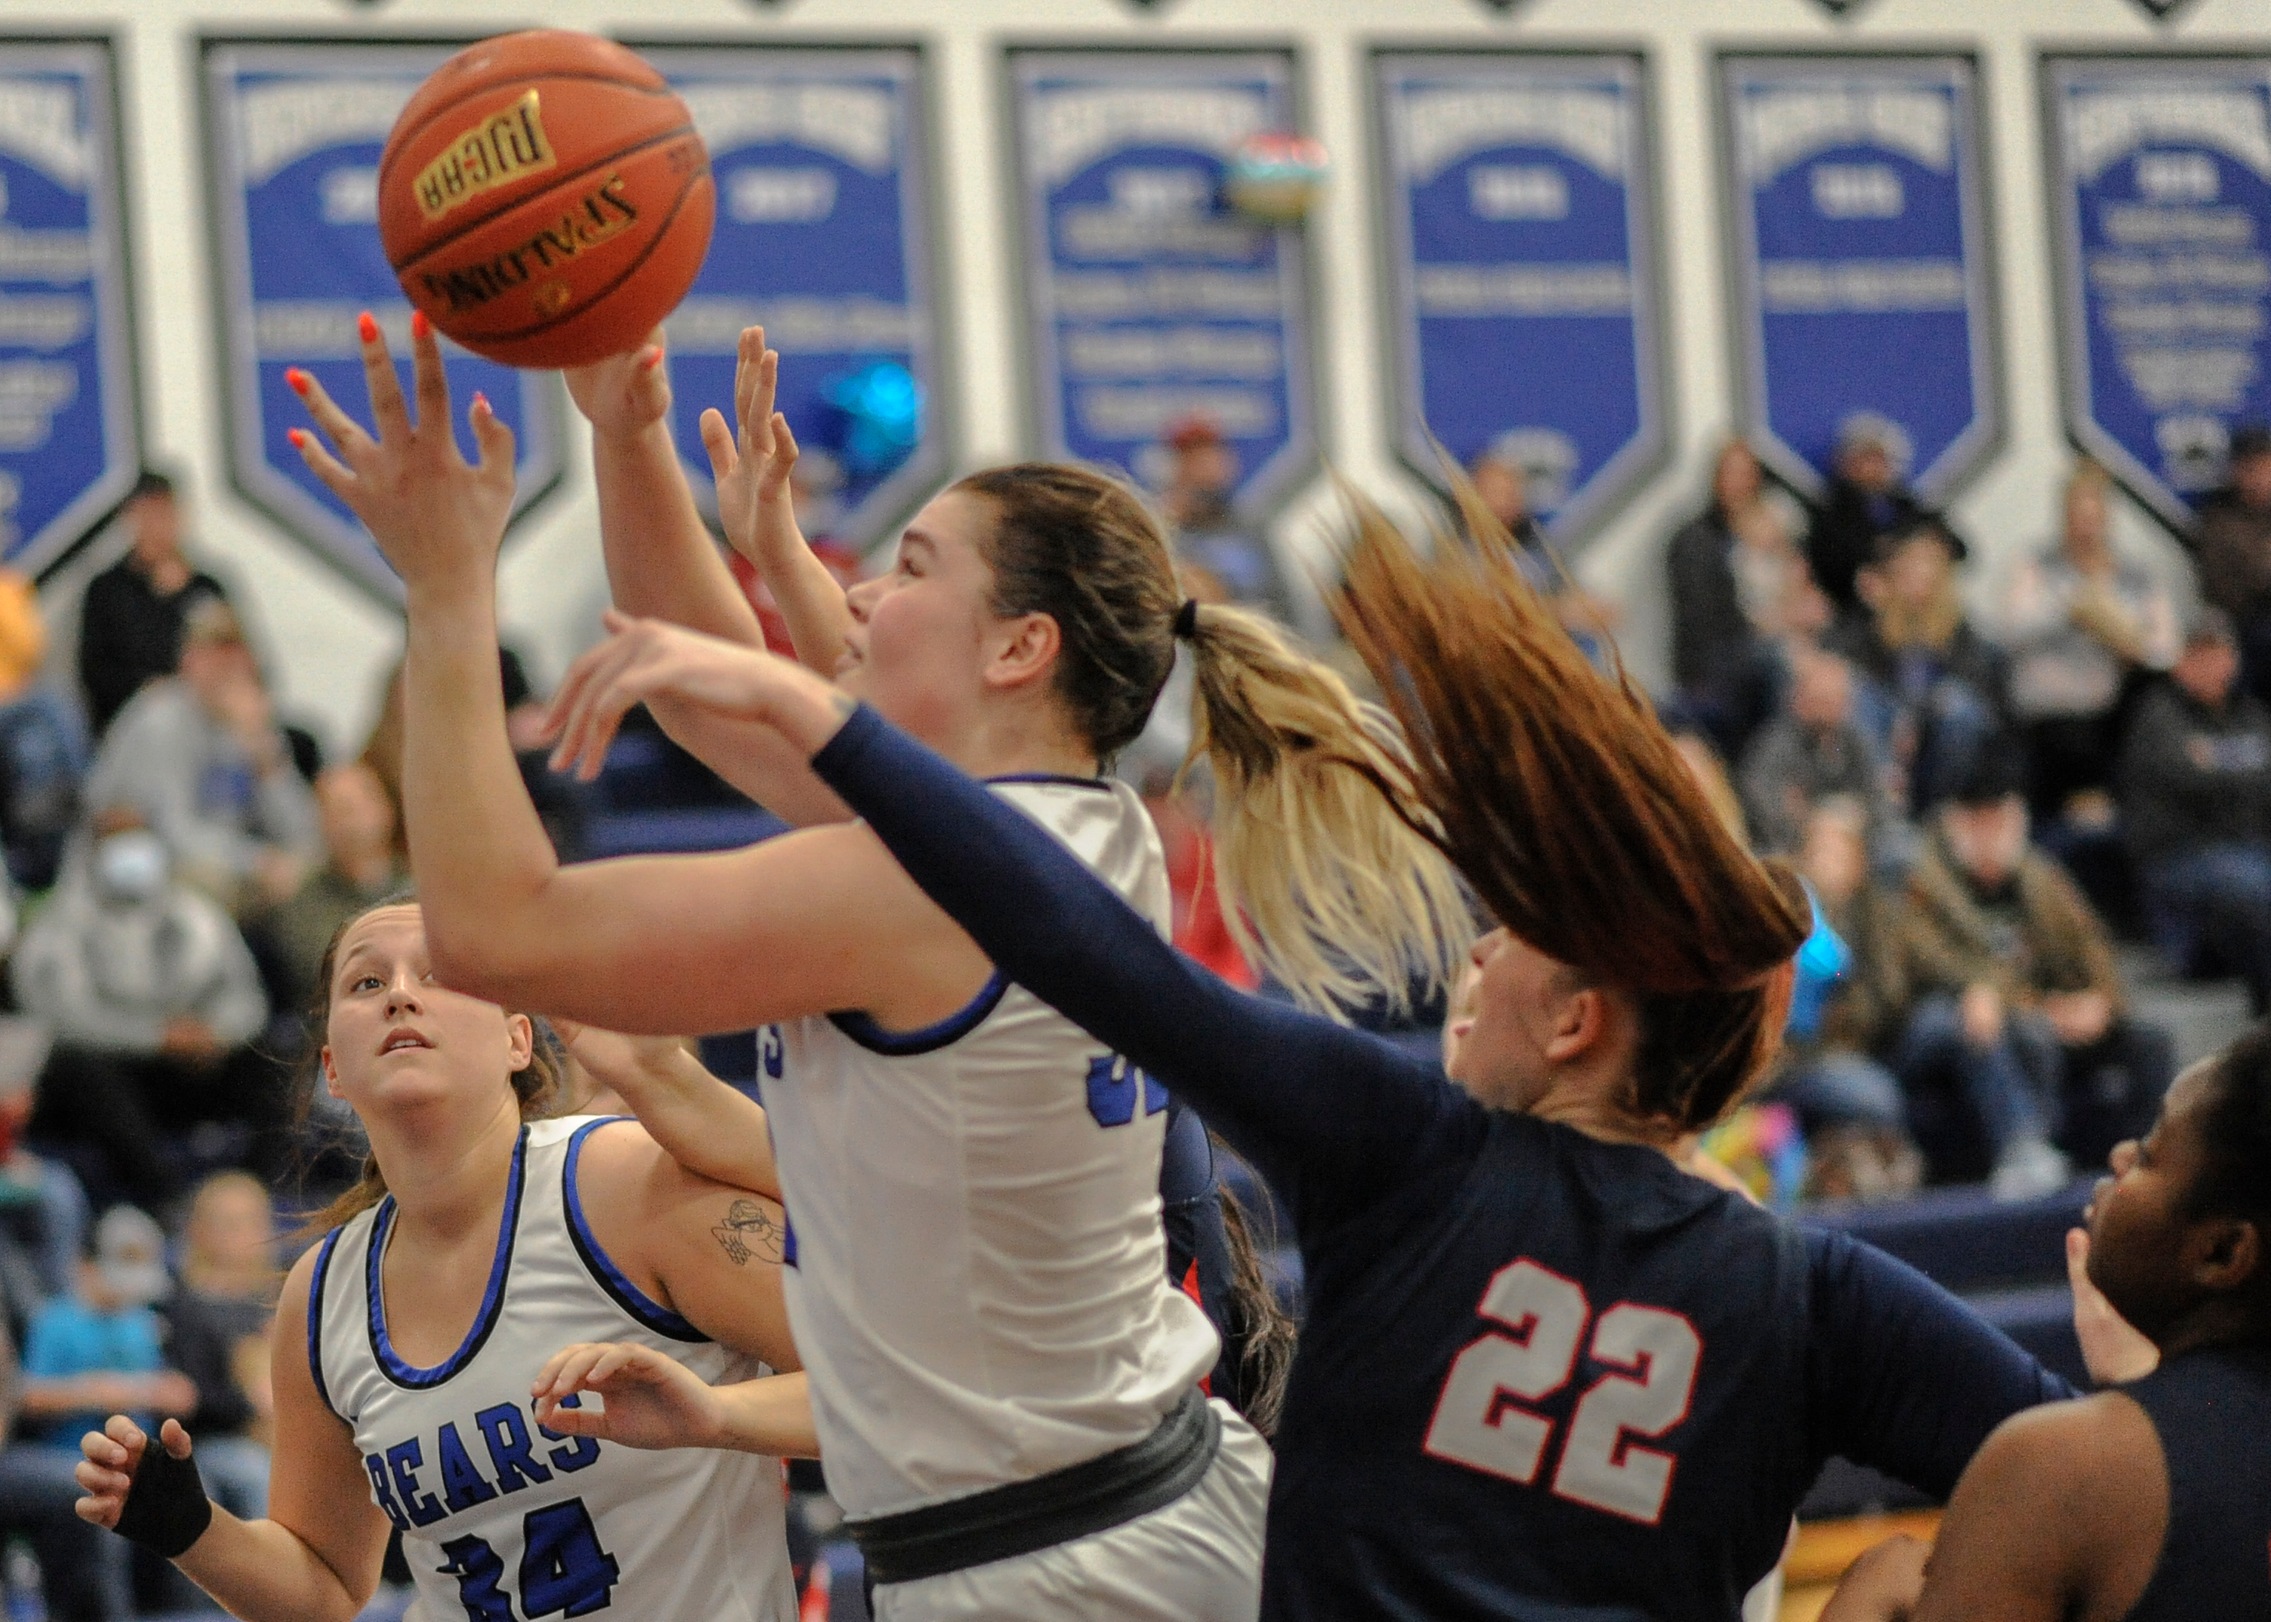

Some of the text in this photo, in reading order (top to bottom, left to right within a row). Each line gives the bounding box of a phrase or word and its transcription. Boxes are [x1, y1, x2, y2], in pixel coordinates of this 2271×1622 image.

[420, 102, 545, 213] NJCAA
[422, 172, 638, 312] SPALDING
[1423, 1256, 1705, 1527] 22
[366, 1392, 601, 1531] BEARS
[436, 1496, 620, 1622] 34
